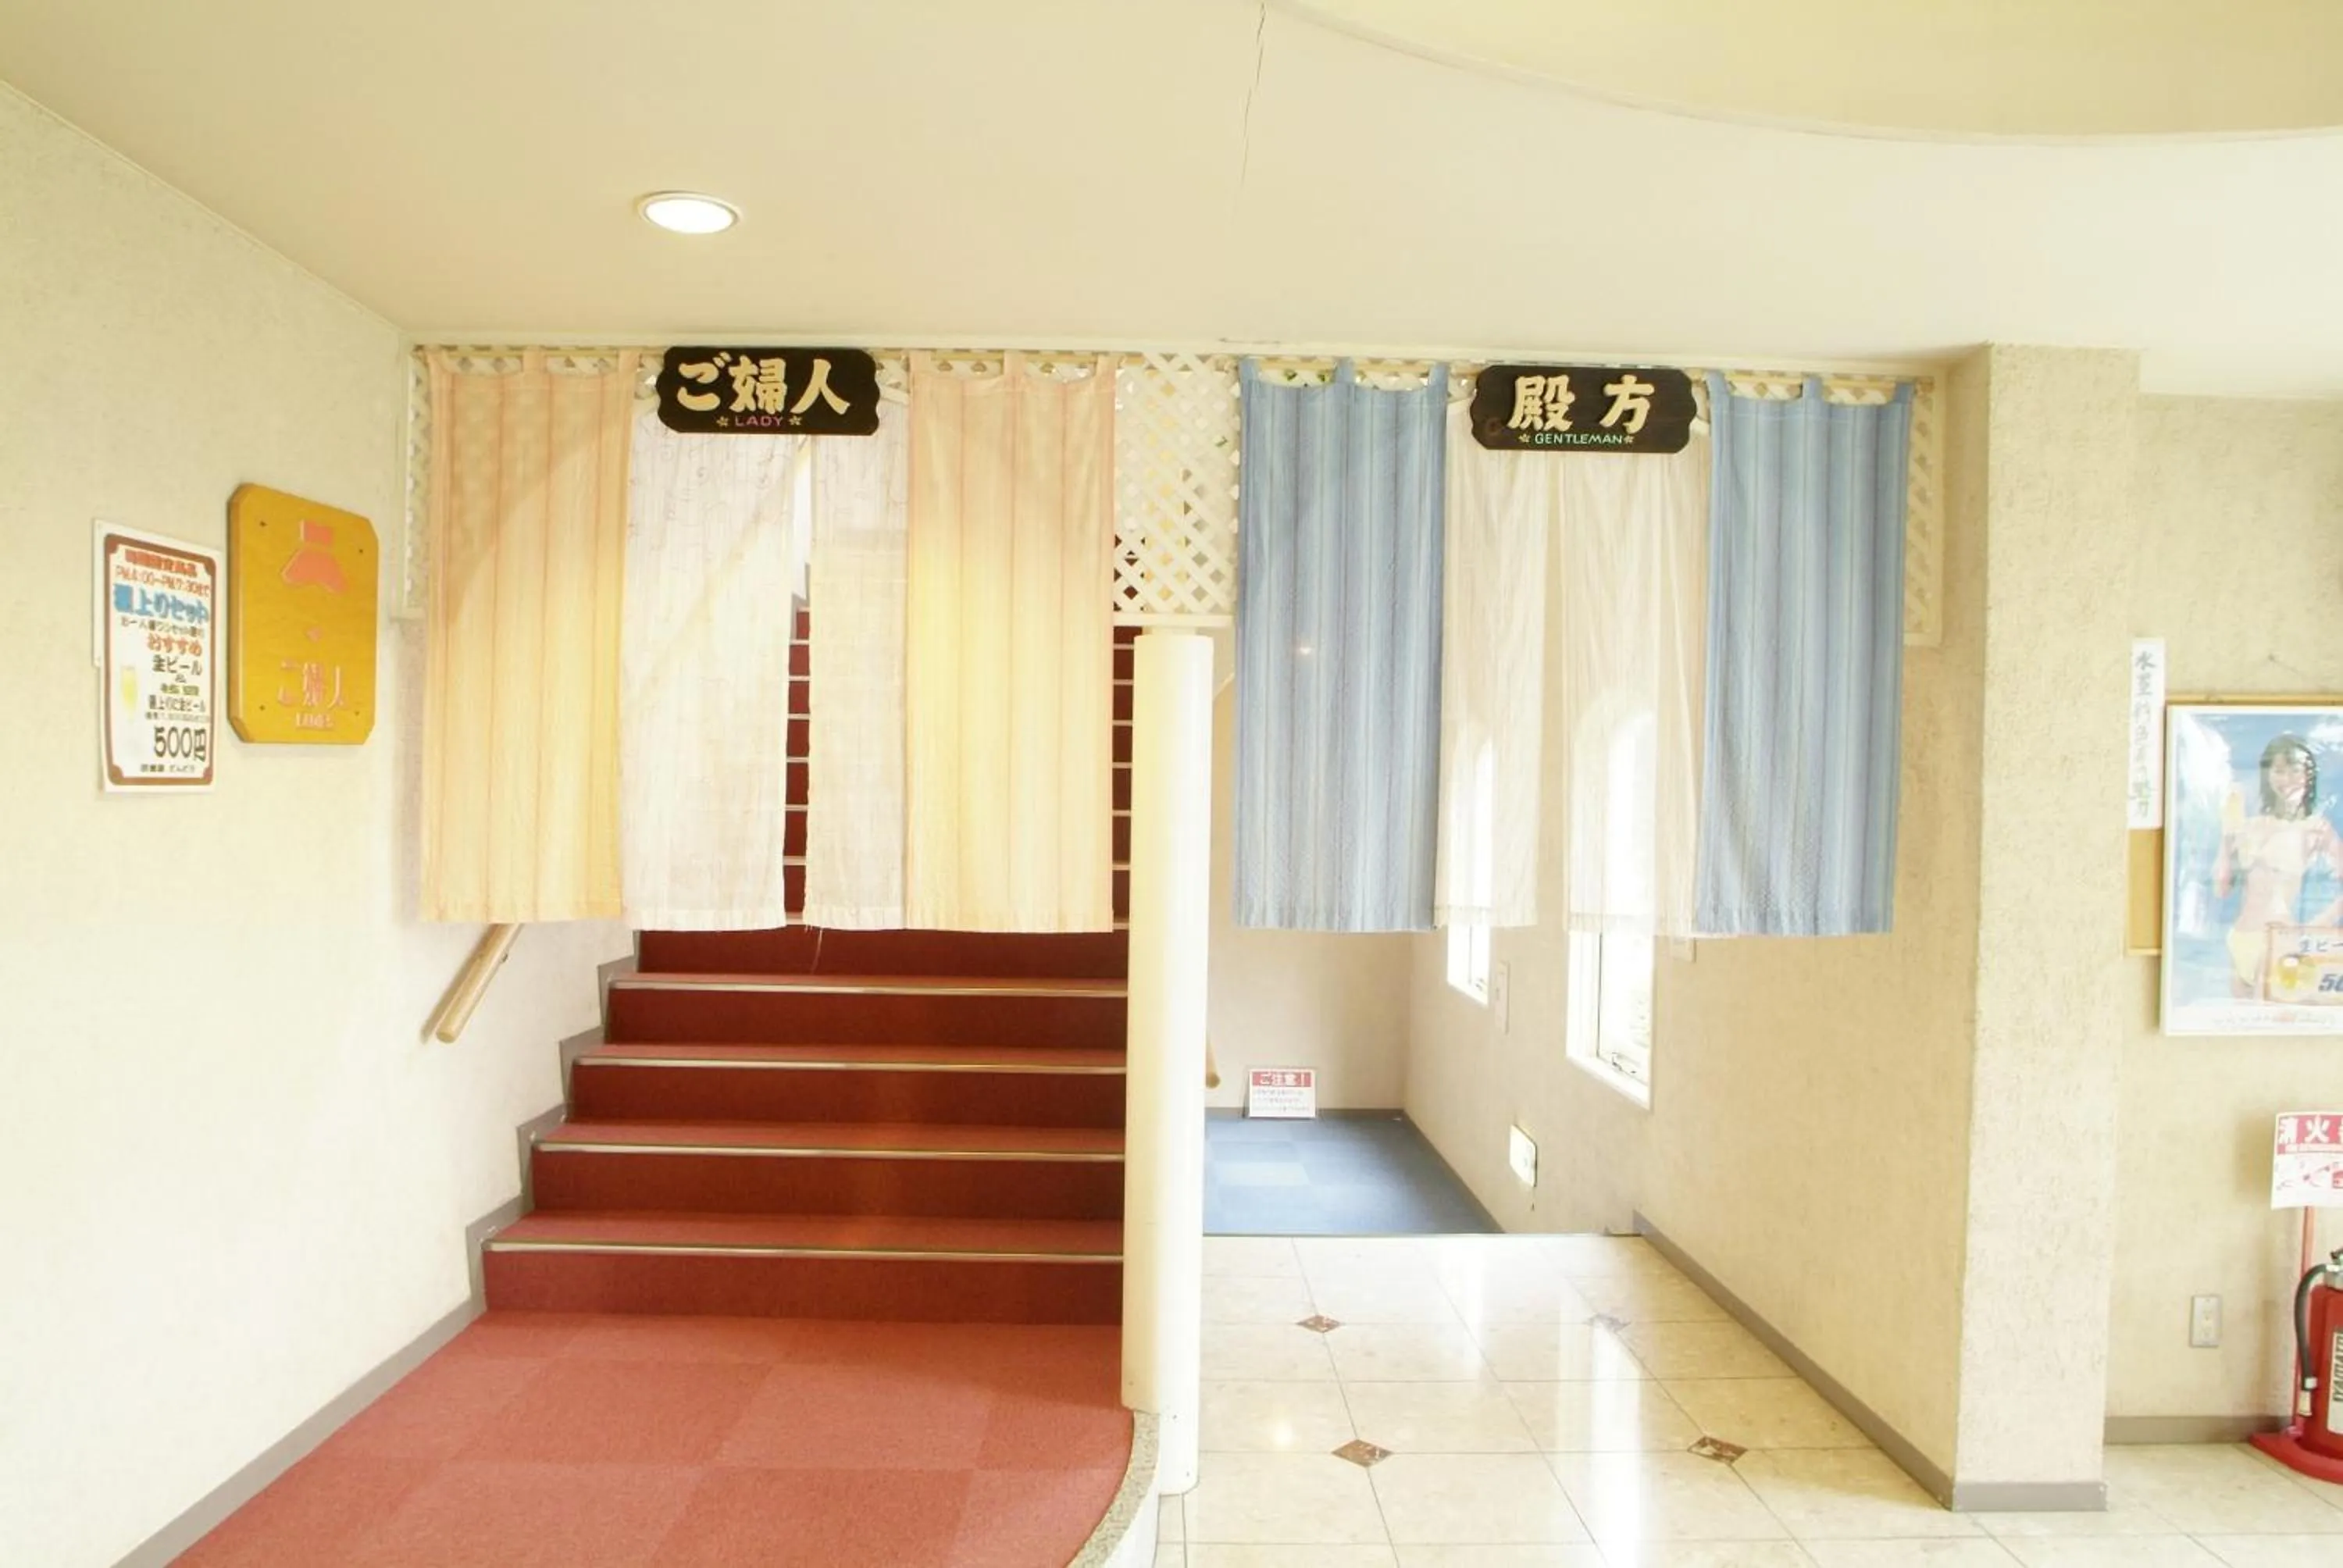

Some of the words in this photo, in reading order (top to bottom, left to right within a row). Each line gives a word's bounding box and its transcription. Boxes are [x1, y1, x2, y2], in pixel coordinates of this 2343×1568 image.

[677, 352, 851, 415] ご婦人
[1507, 374, 1655, 434] 殿方
[734, 415, 783, 426] LADY
[1534, 433, 1623, 445] GENTLEMAN
[152, 654, 202, 675] 生ビール
[2278, 1116, 2343, 1145] 消火
